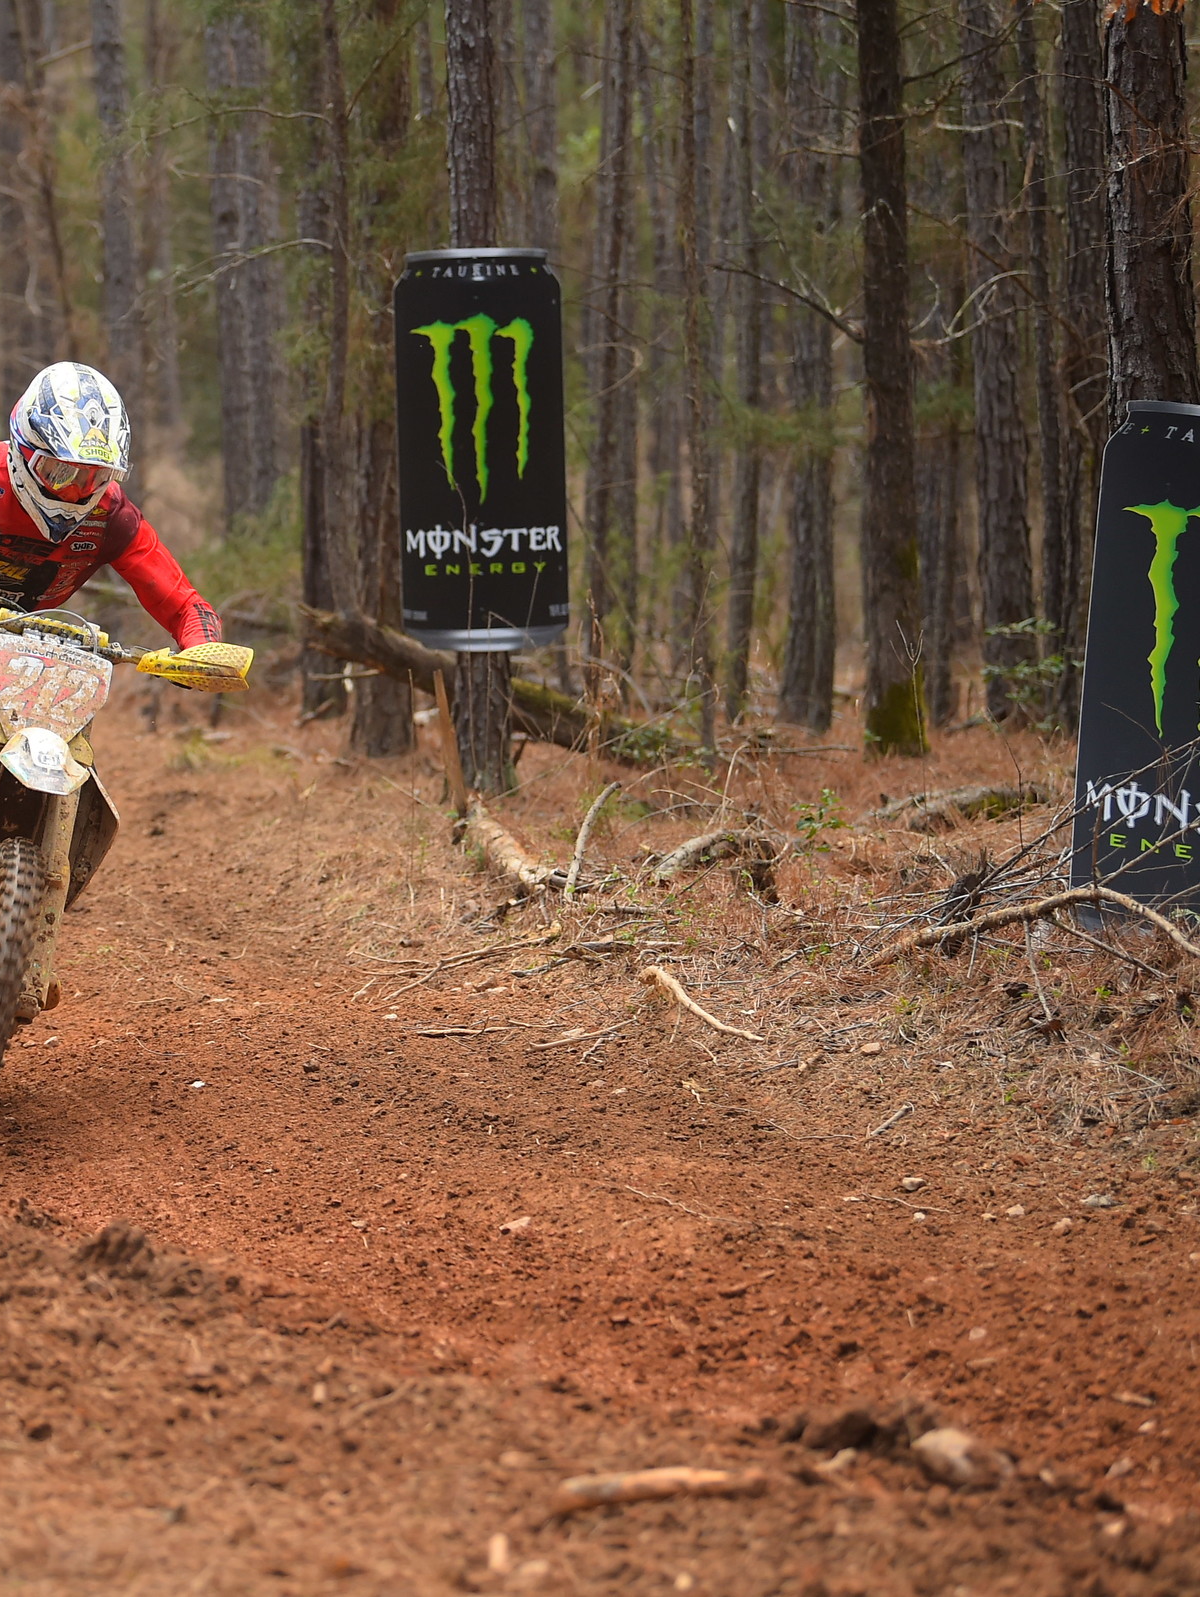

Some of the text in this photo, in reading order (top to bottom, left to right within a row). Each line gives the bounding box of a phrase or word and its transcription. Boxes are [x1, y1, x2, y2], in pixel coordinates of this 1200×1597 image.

[85, 448, 111, 460] SHOEI
[406, 523, 562, 560] MONSTER
[425, 561, 546, 576] ENERGY
[1086, 780, 1200, 834] MON
